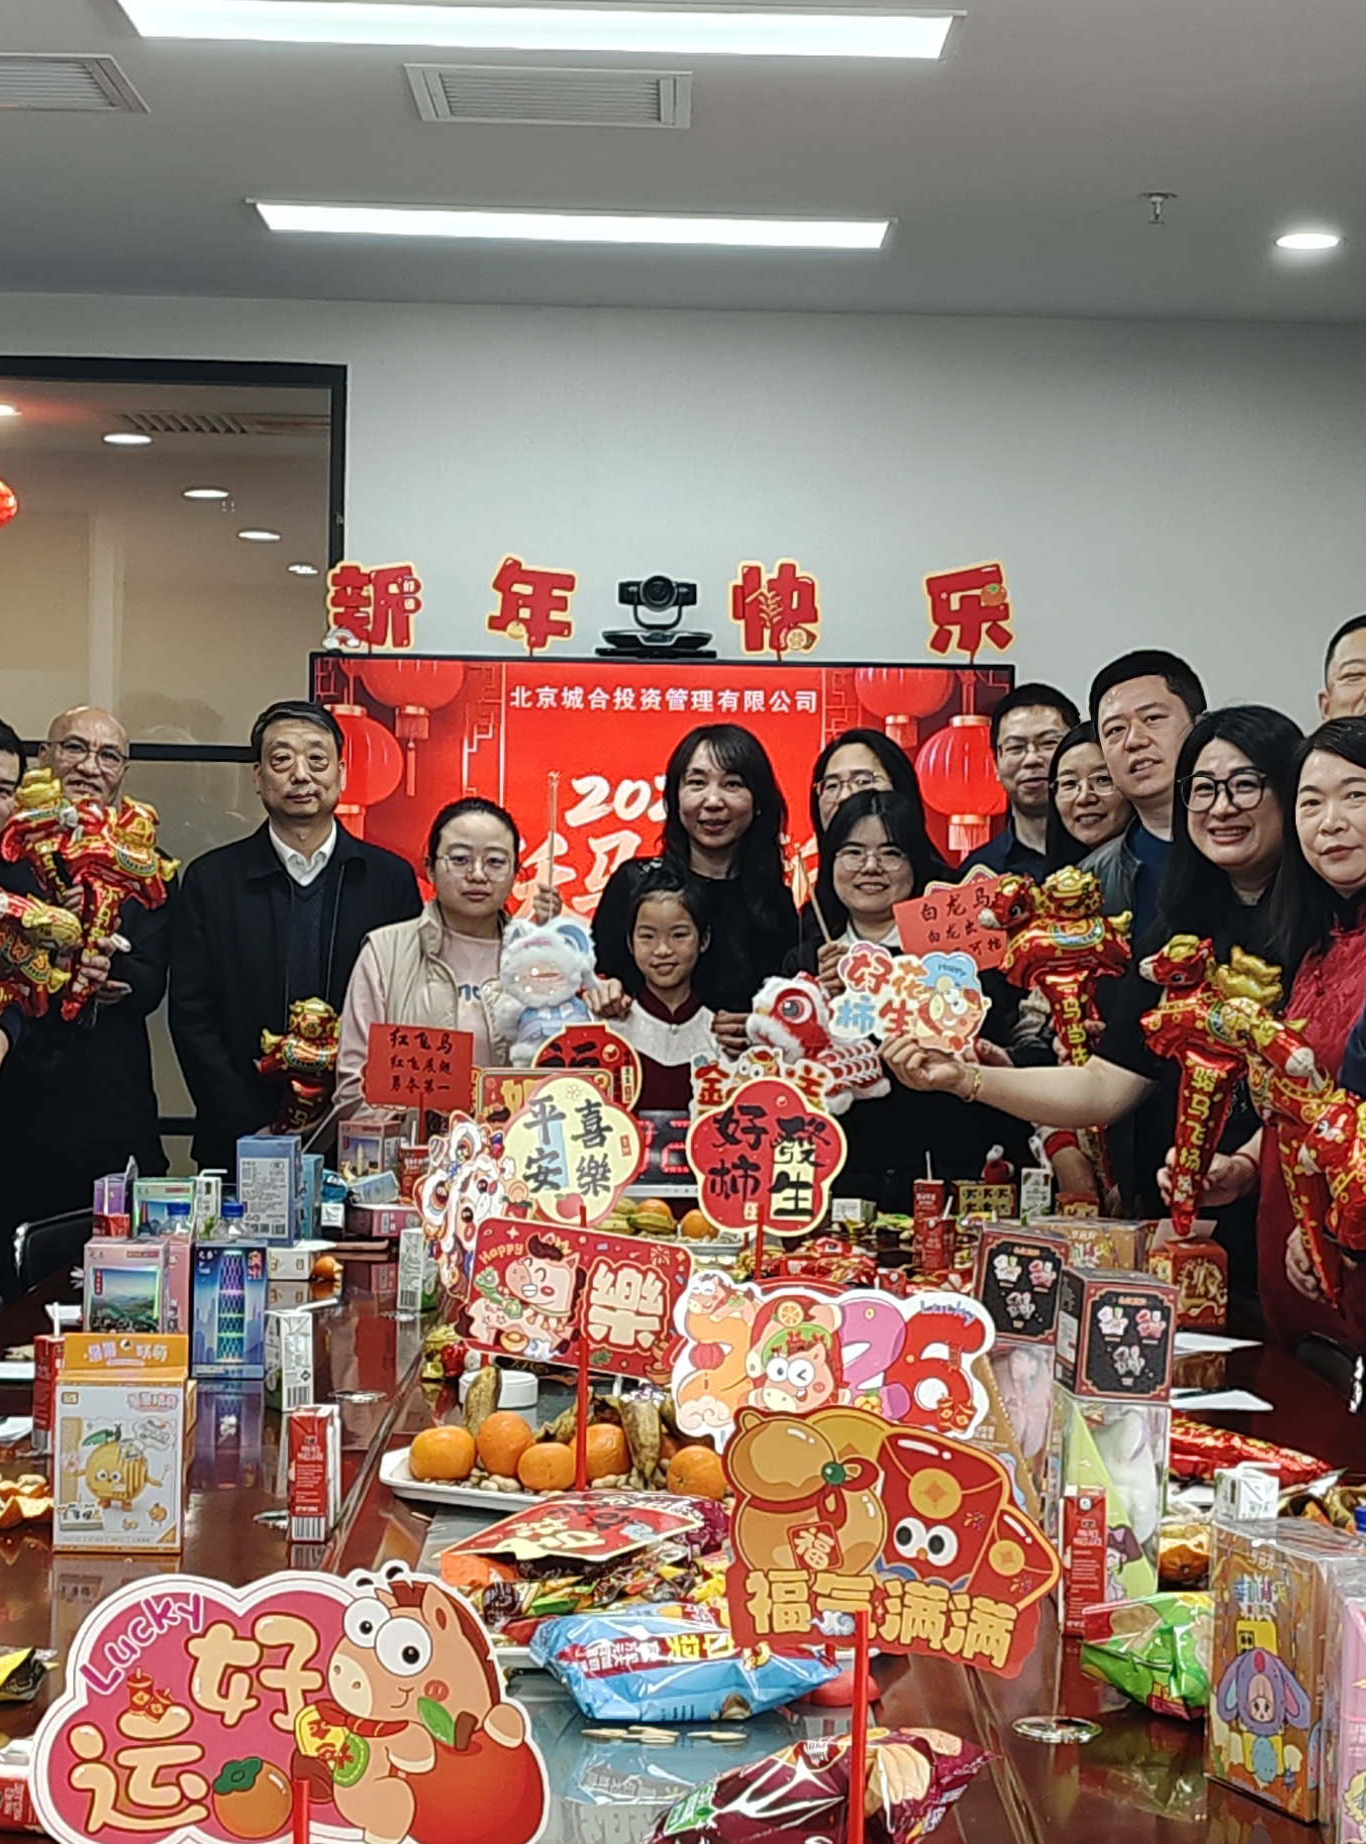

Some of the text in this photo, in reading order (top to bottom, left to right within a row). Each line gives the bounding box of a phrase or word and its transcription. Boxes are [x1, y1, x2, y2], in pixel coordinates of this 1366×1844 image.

[329, 561, 1013, 652] 新 年 快 乐
[509, 685, 819, 714] 北京城合投资管理有限公司
[921, 887, 995, 922] 白龙马
[389, 1027, 453, 1055] 红飞马
[478, 1242, 524, 1265] Happy
[587, 1262, 665, 1350] 樂
[793, 1527, 836, 1570] 福
[79, 1593, 204, 1696] Lucky
[745, 1569, 1019, 1668] 福气满满
[187, 1614, 324, 1732] 好
[66, 1708, 209, 1834] 运
